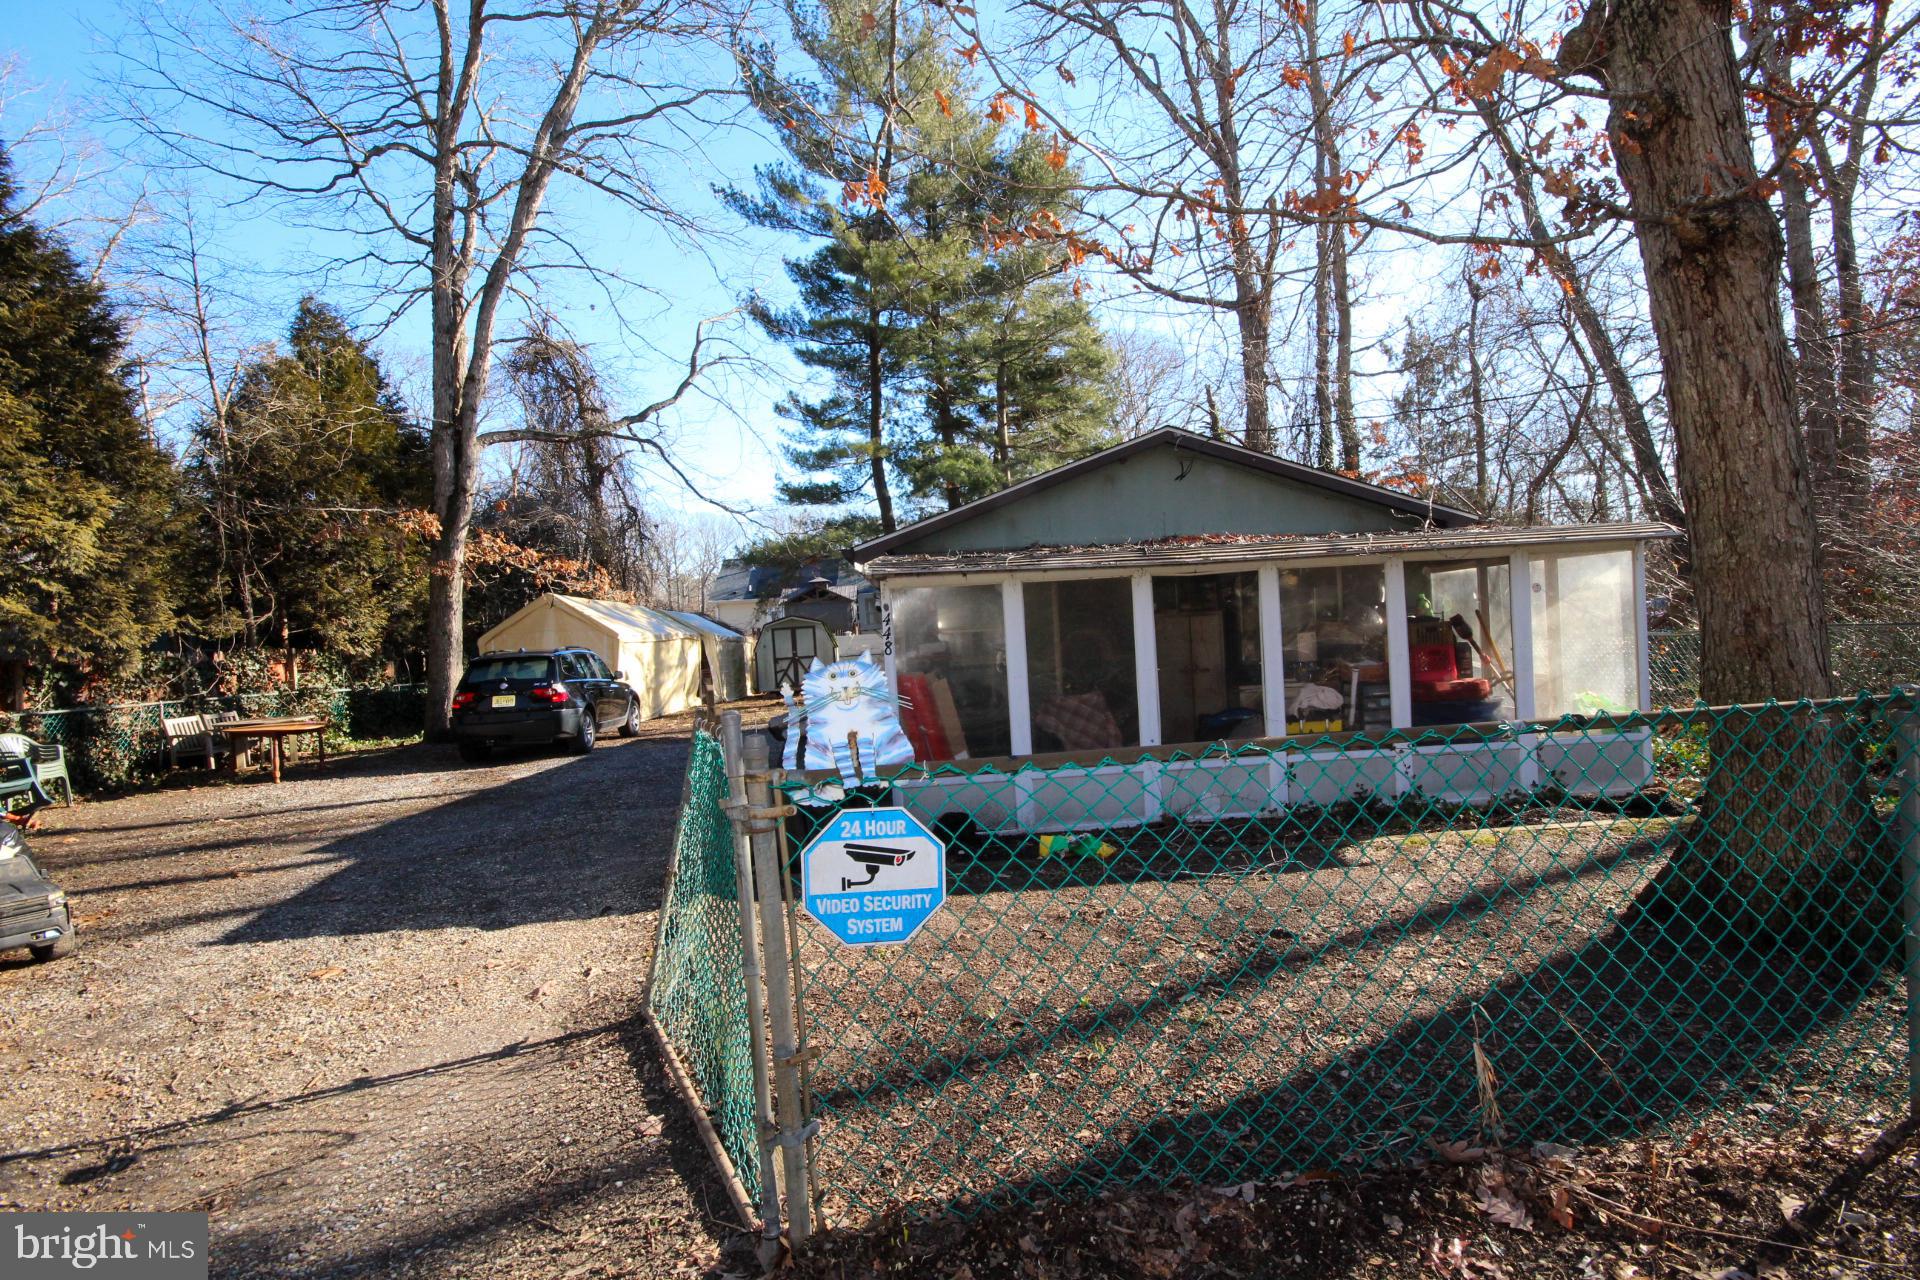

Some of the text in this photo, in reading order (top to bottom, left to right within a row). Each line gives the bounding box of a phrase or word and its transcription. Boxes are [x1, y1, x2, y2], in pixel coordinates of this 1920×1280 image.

[882, 612, 893, 656] 448
[840, 819, 906, 838] 24 HOUR
[816, 894, 932, 915] VIDEO SECURITY
[847, 917, 903, 935] SYSTEM
